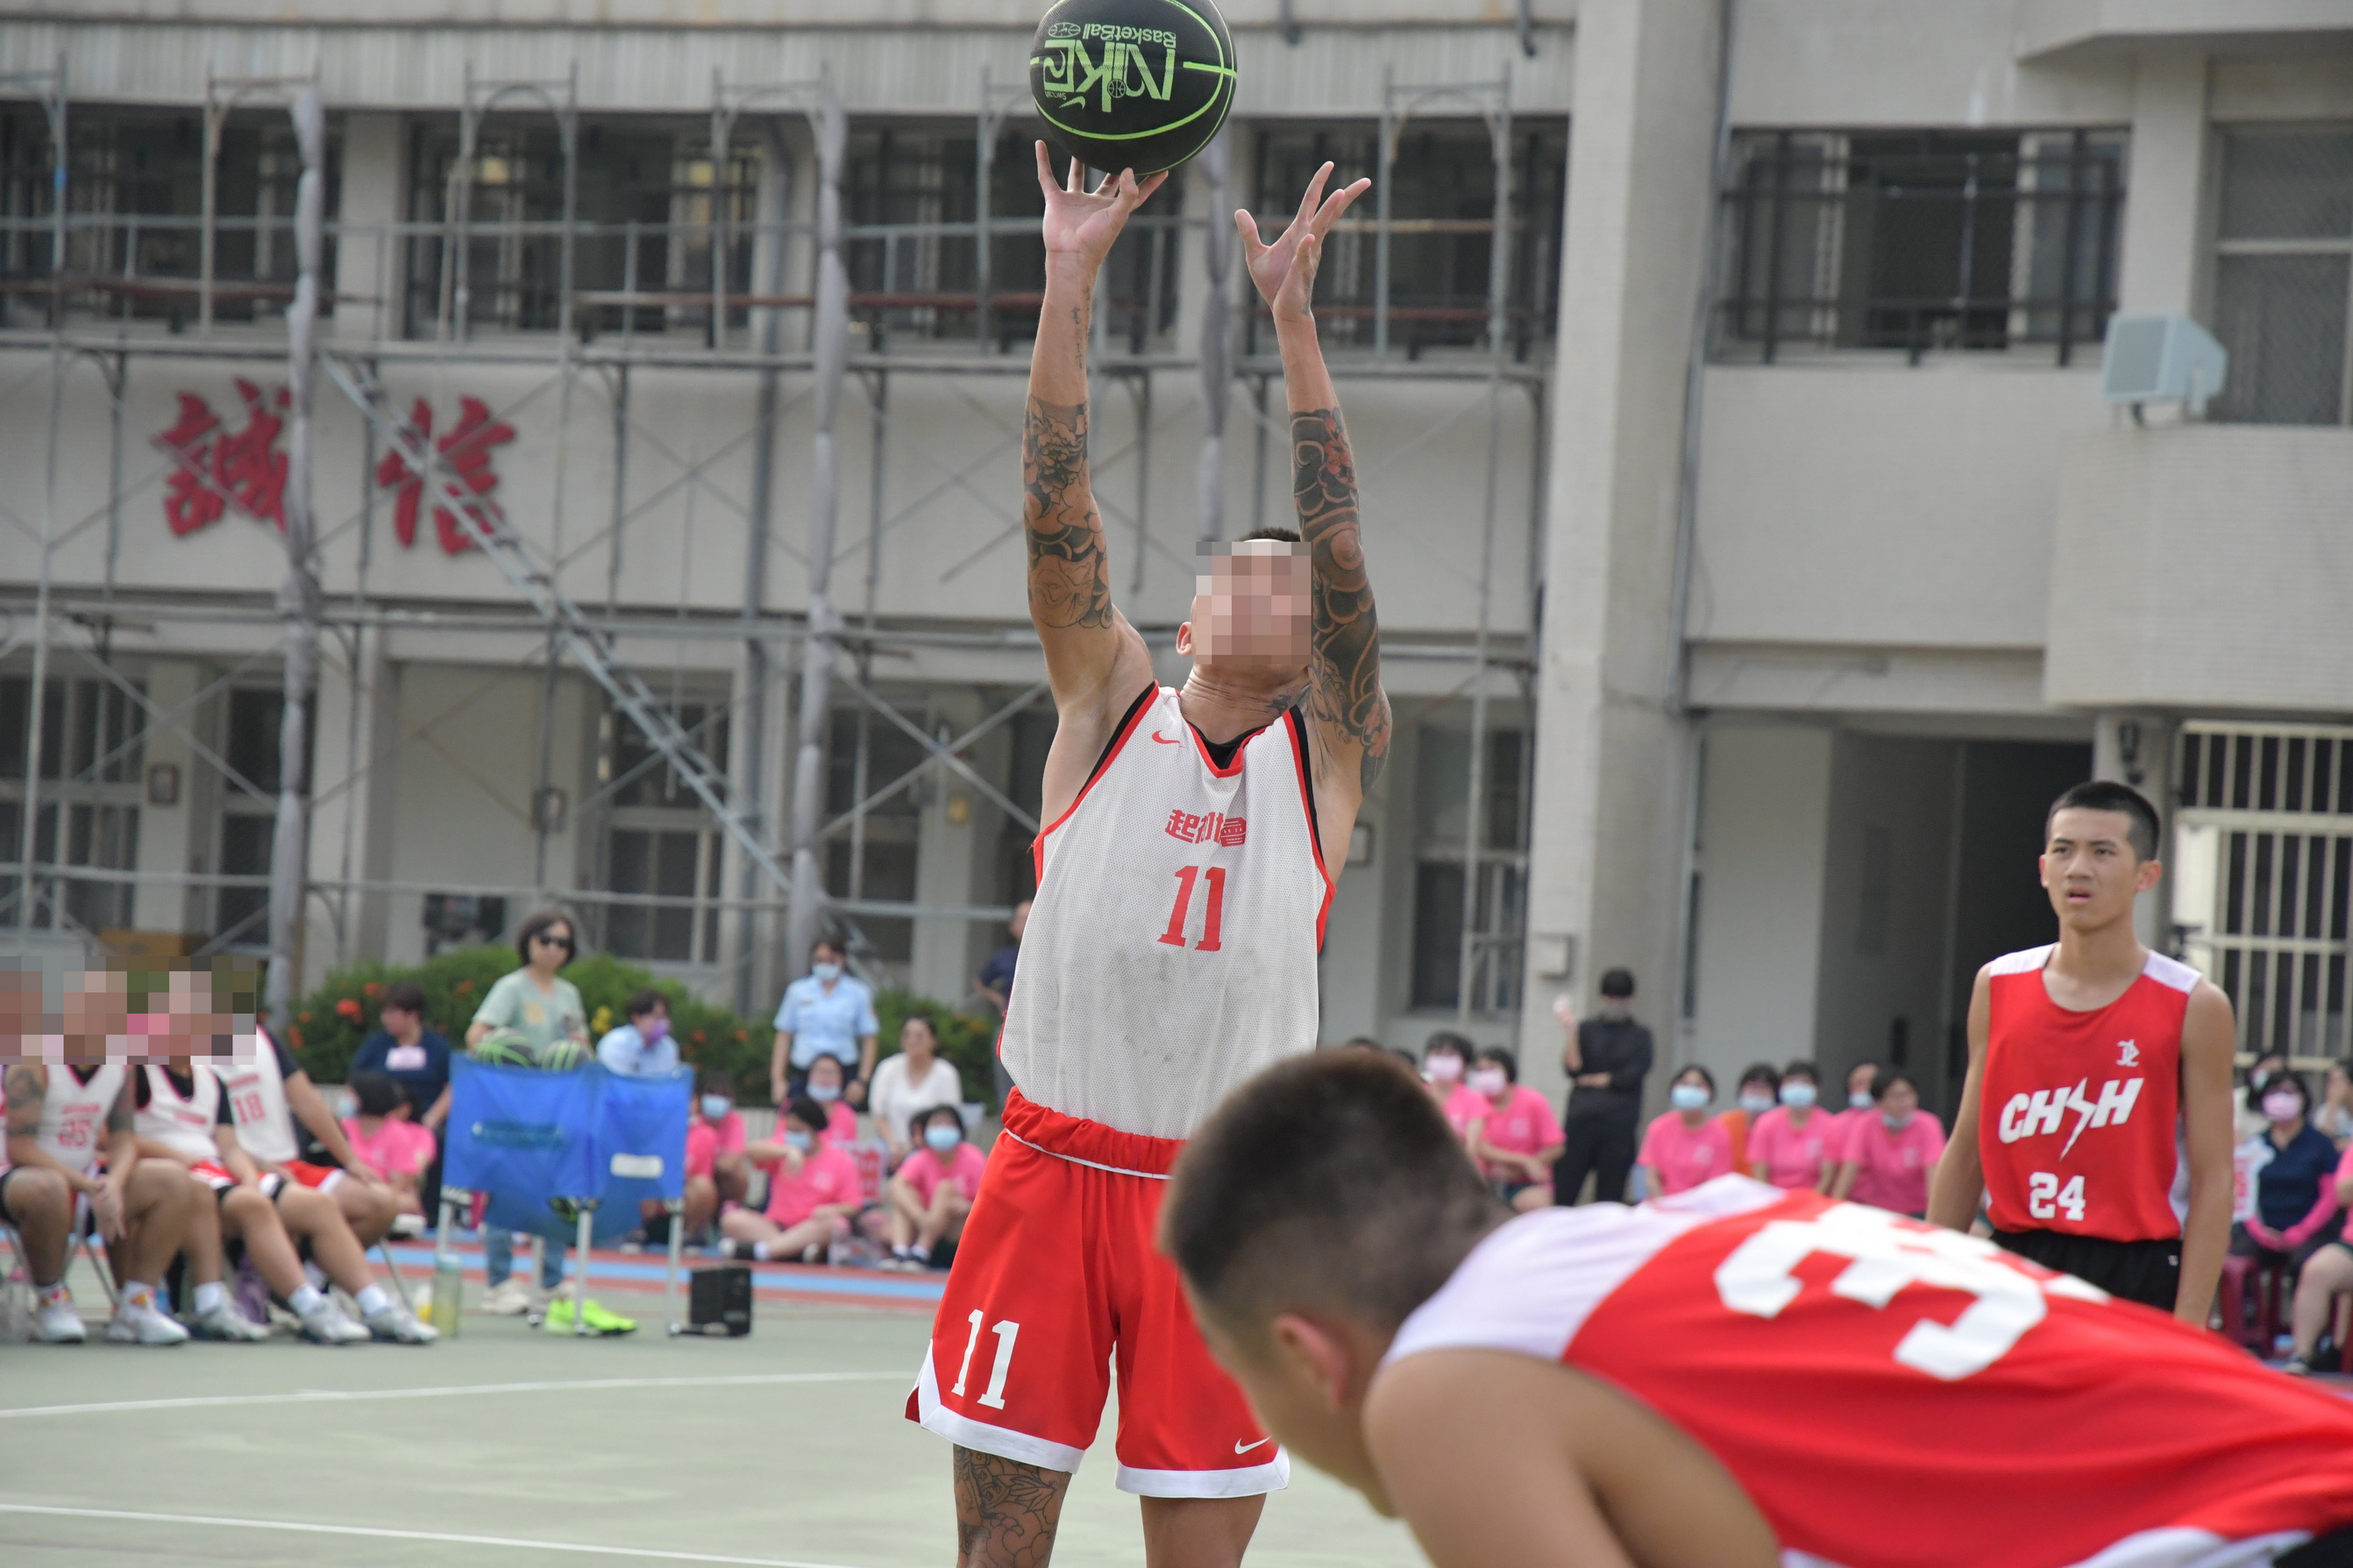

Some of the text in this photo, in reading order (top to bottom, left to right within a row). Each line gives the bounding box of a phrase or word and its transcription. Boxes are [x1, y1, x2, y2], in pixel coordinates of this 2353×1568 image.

[1156, 865, 1226, 952] 11
[232, 1091, 266, 1125] 18
[2029, 1171, 2086, 1221] 24
[951, 1309, 1020, 1410] 11
